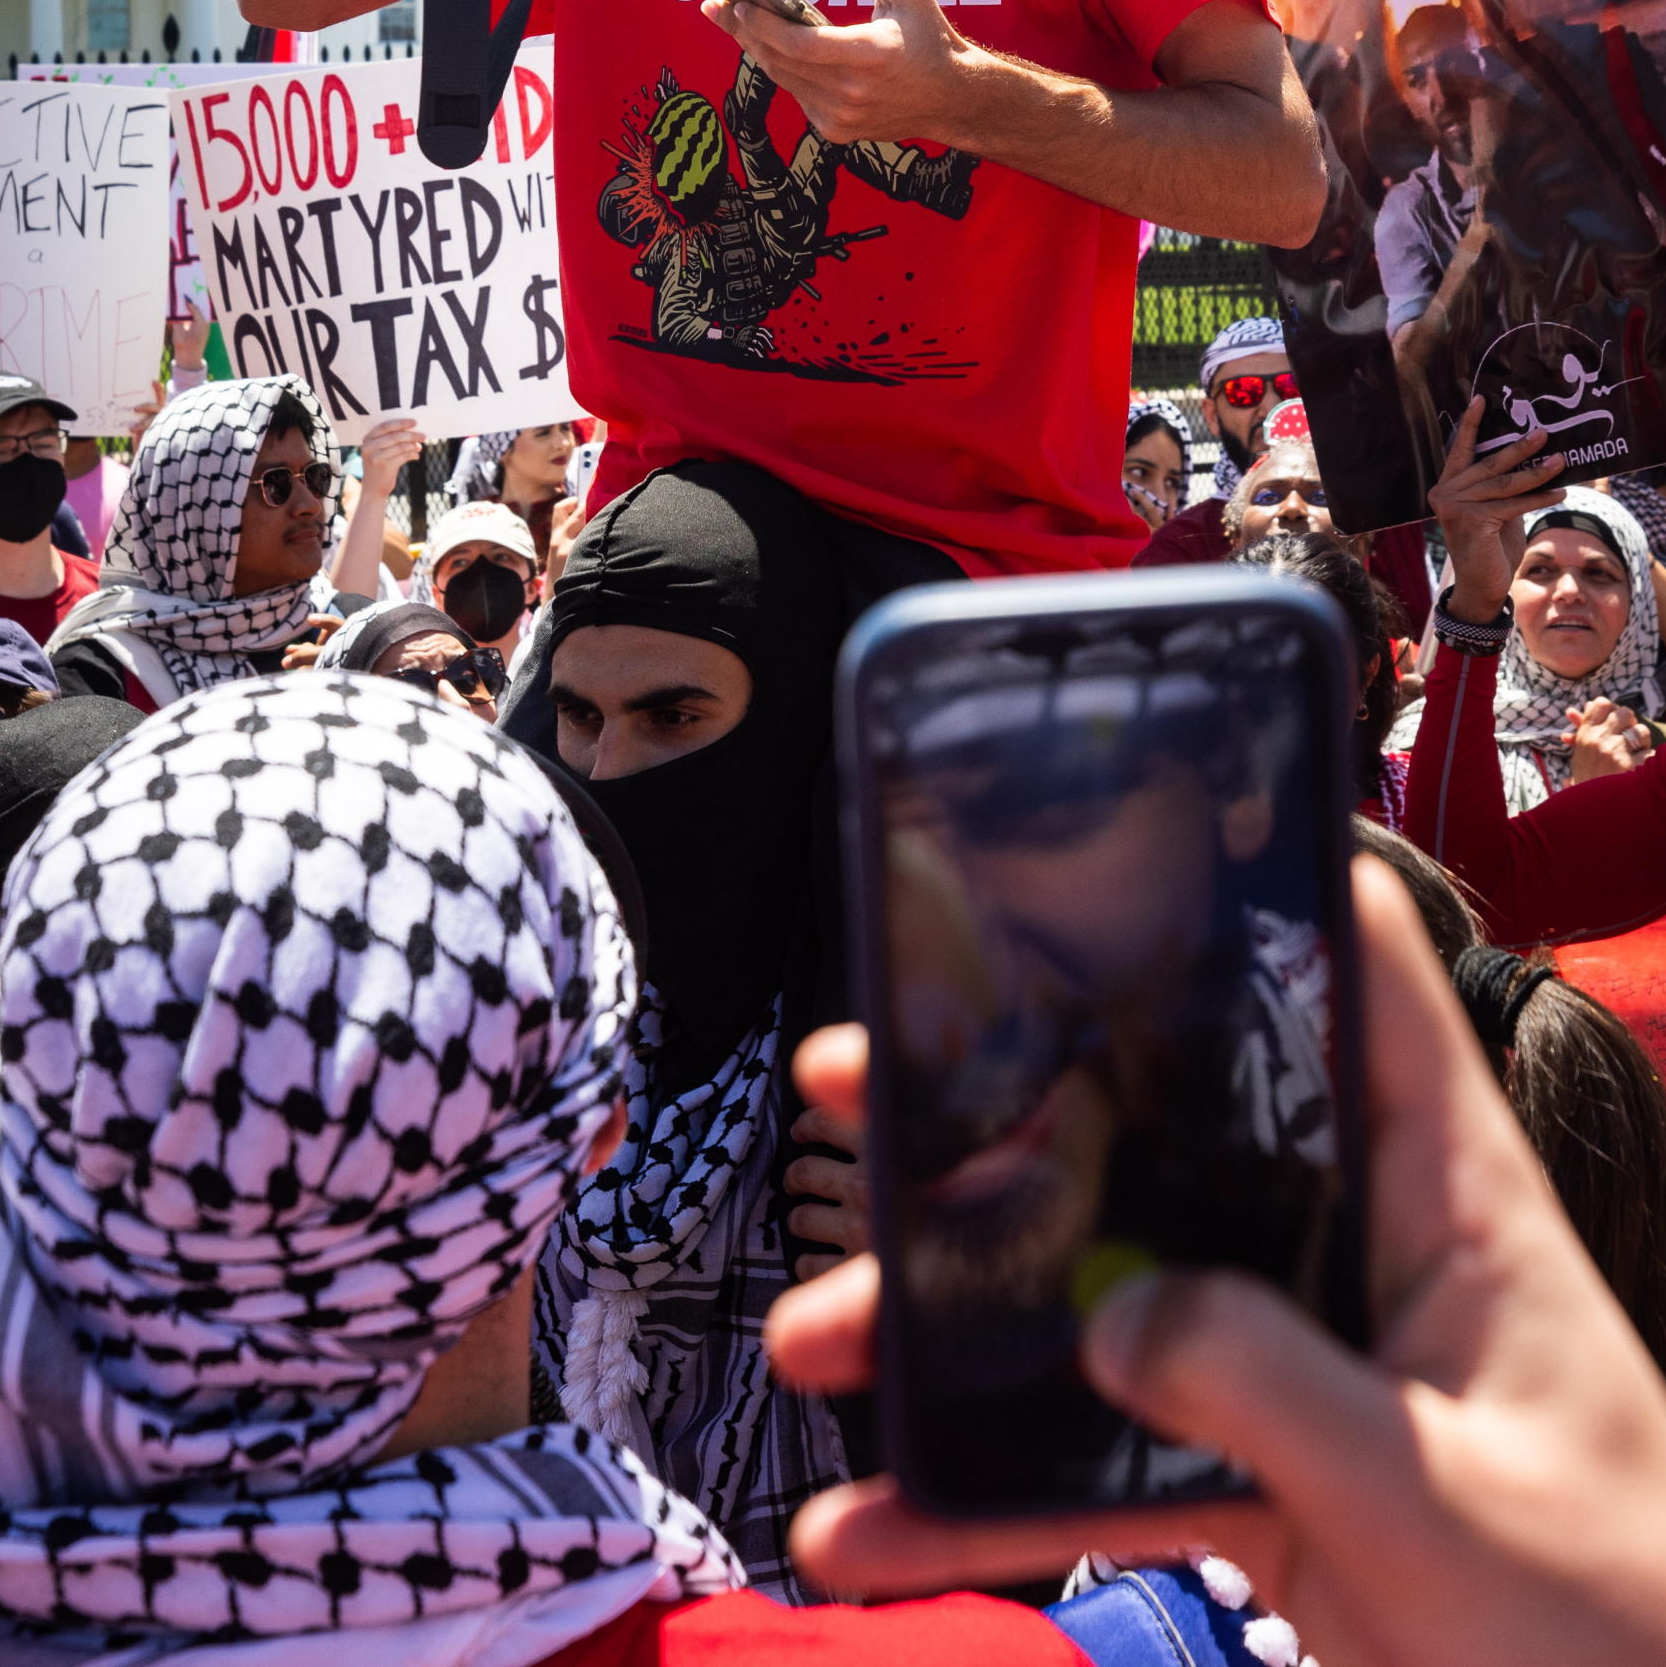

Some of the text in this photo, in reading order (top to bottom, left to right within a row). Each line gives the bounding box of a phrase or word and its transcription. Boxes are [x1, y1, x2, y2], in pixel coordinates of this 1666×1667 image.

[183, 73, 358, 214] 15,000
[373, 102, 416, 155] +
[211, 176, 503, 312] MARTYRED
[233, 308, 370, 421] OUR
[350, 285, 503, 410] TAX
